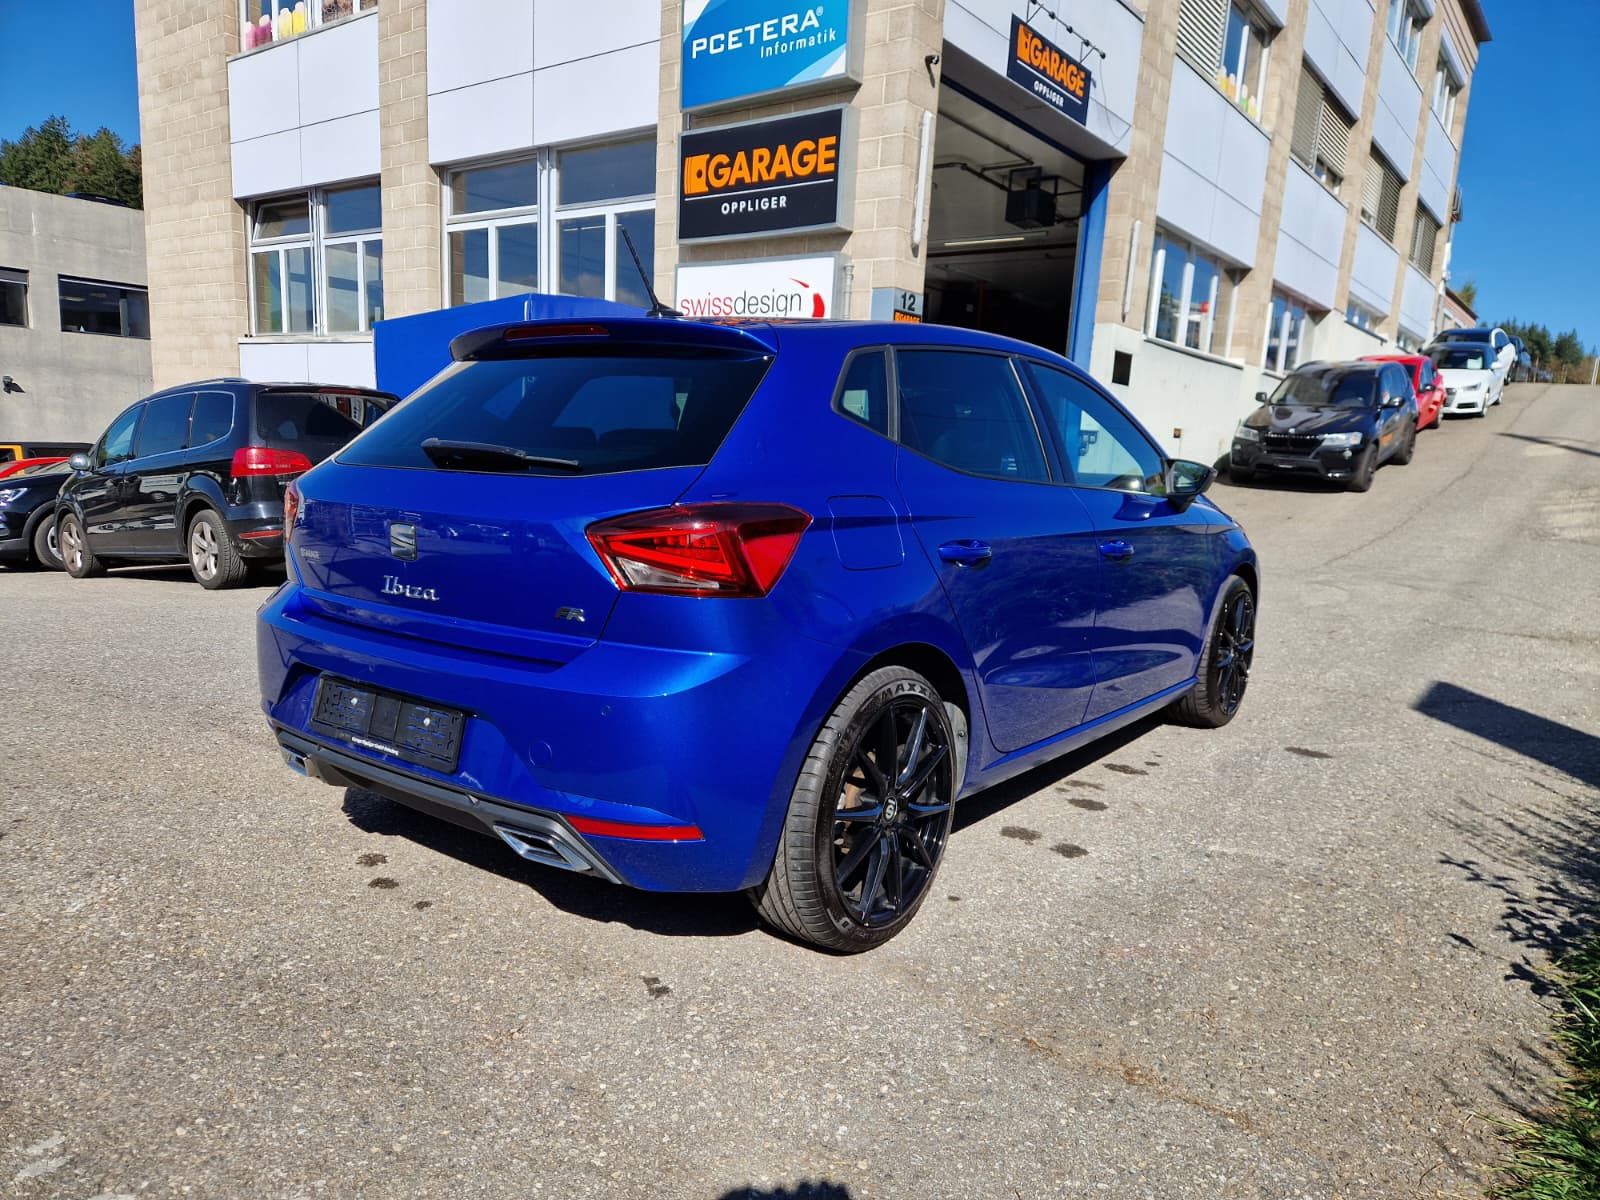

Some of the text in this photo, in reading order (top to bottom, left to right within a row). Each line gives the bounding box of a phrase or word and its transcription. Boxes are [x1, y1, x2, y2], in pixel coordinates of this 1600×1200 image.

[760, 28, 836, 59] Informatik
[1030, 37, 1085, 97] GARAGE
[1033, 80, 1064, 107] OPPLIGER
[707, 136, 836, 188] GARAGE
[721, 196, 787, 215] OPPLIGER
[680, 288, 802, 317] swissdesign
[901, 292, 916, 312] 12
[381, 575, 440, 601] Ibiza
